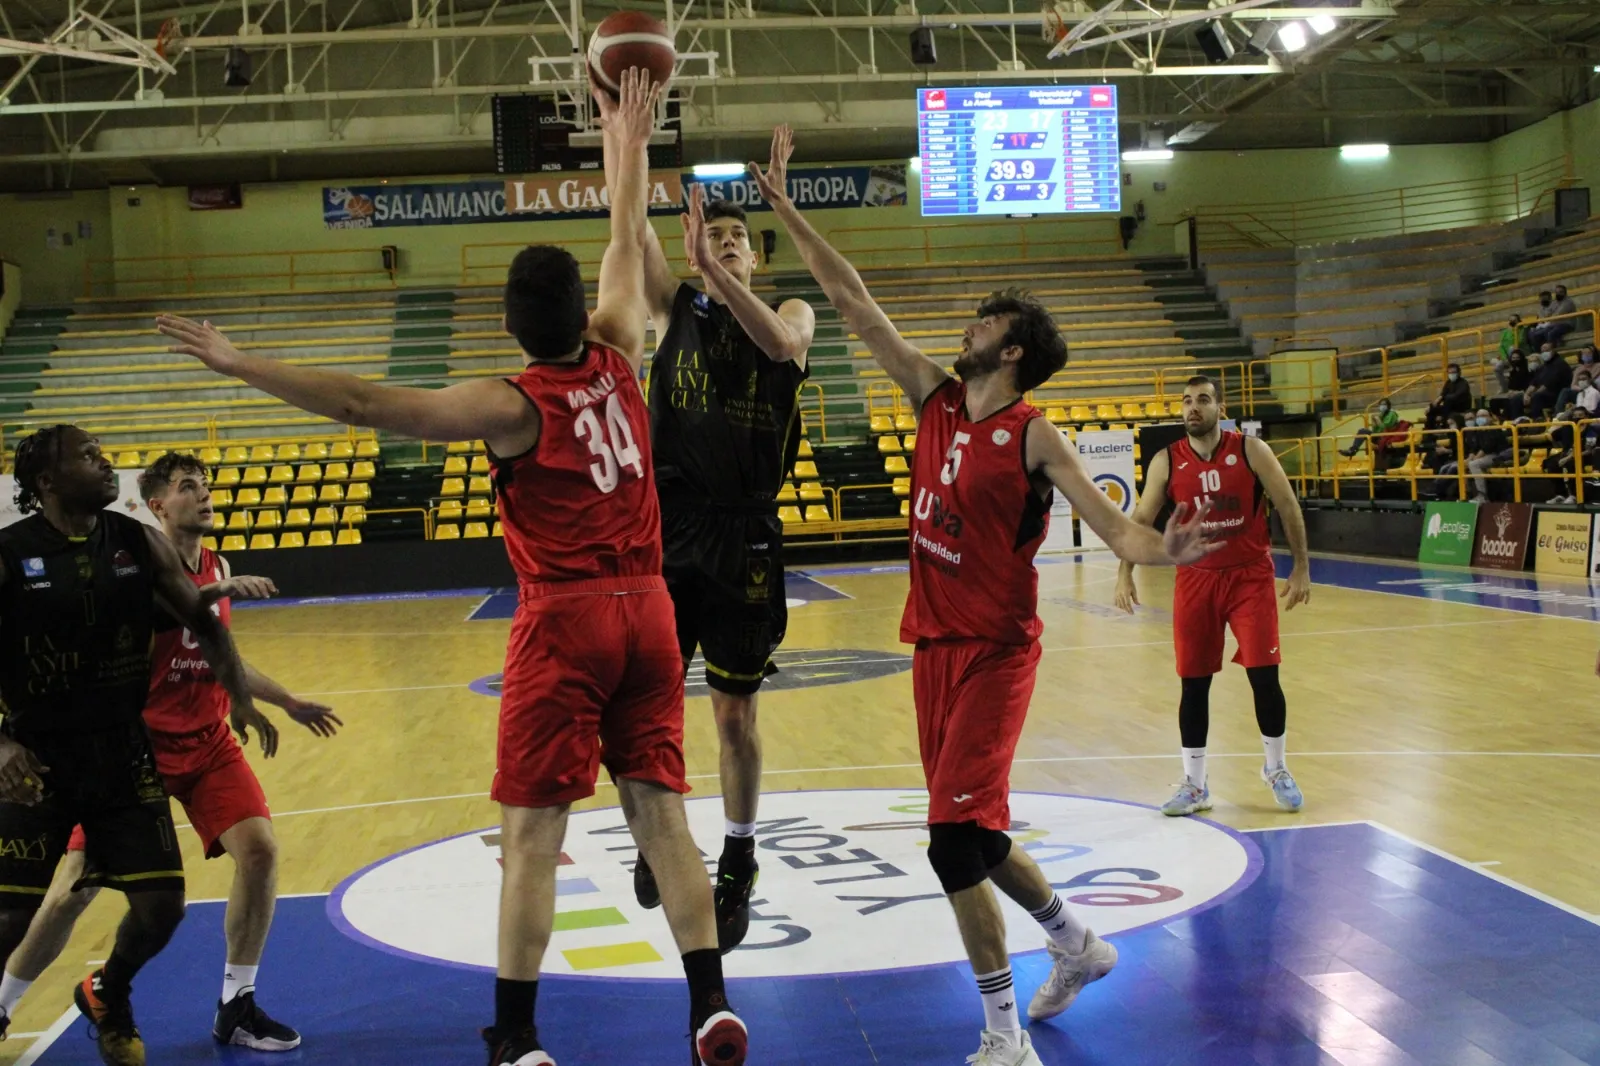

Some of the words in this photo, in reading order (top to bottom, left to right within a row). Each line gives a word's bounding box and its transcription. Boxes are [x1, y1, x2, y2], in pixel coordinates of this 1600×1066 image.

[990, 160, 1035, 181] 39.9
[374, 190, 506, 221] SALAMANC
[788, 176, 860, 205] UROPA
[513, 181, 554, 212] LA
[993, 185, 1005, 201] 3
[1037, 184, 1049, 200] 3
[567, 372, 616, 409] MANU
[574, 392, 644, 494] 34
[940, 431, 971, 485] 5
[1198, 469, 1221, 493] 10
[1538, 534, 1553, 549] El
